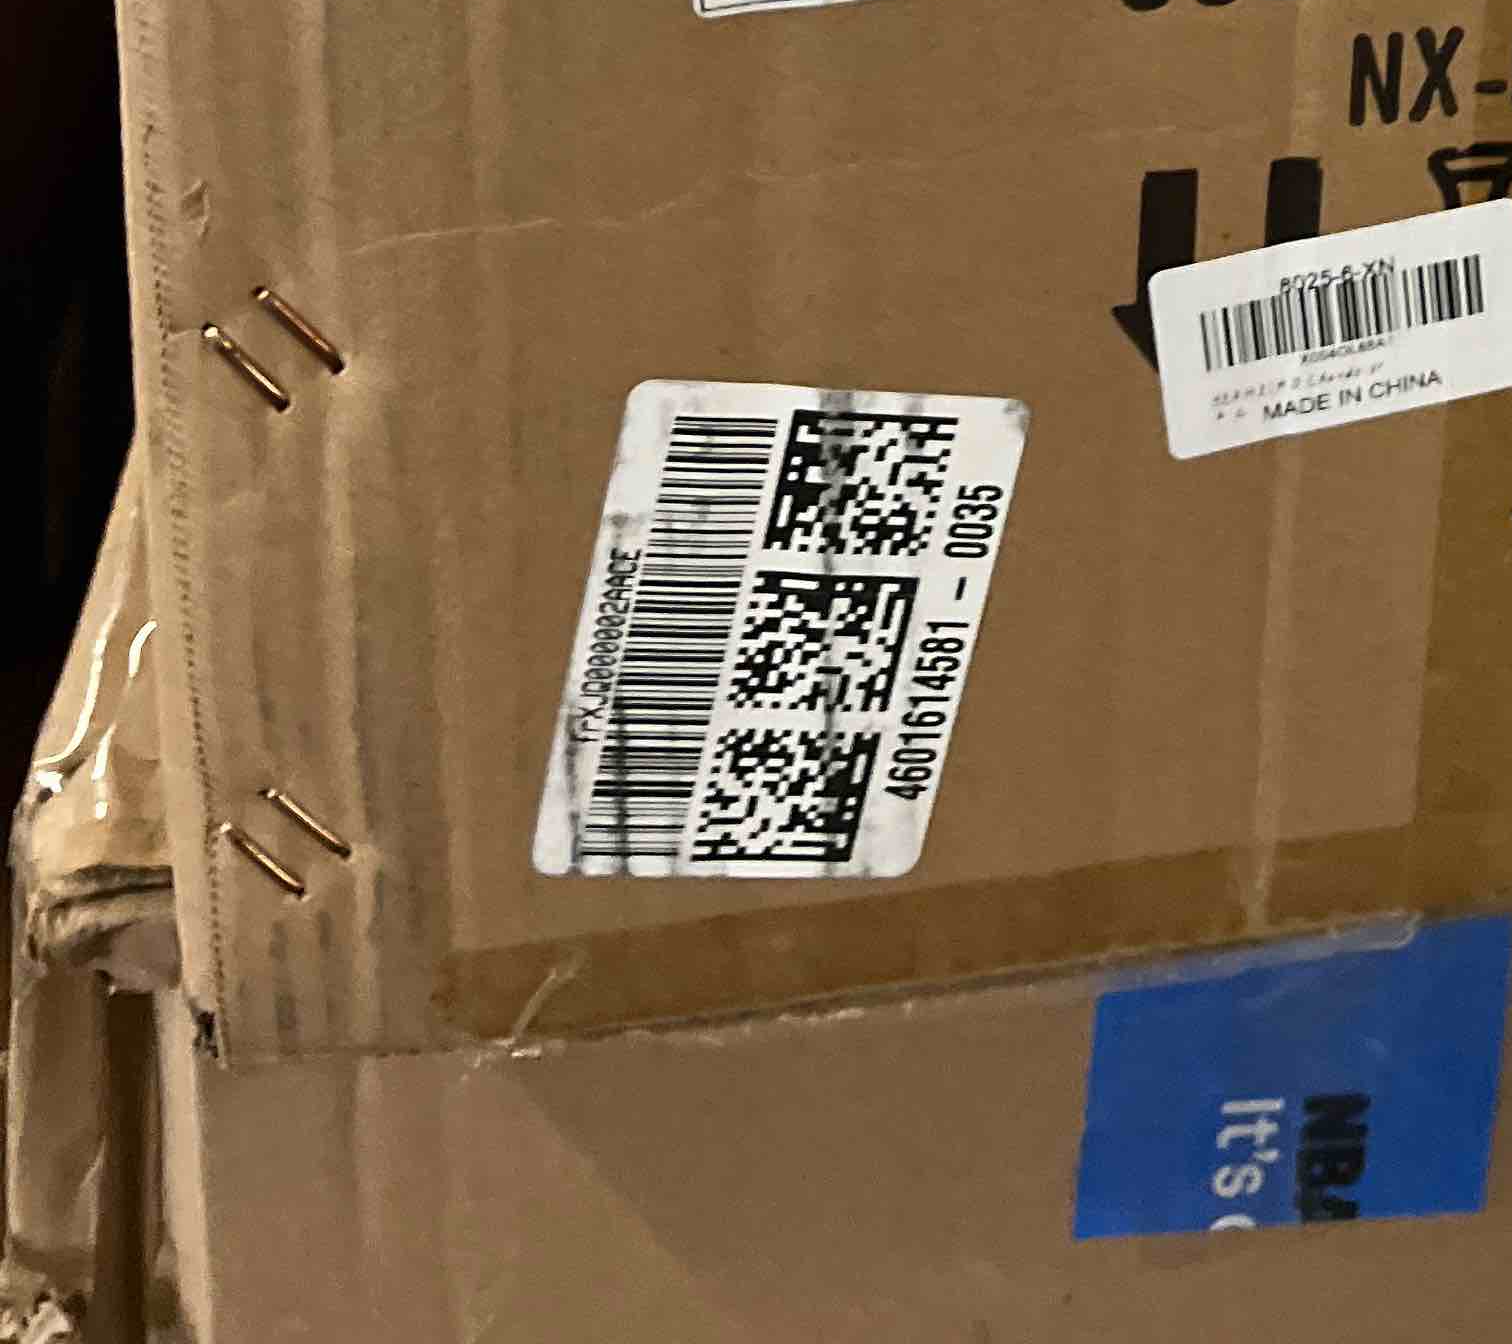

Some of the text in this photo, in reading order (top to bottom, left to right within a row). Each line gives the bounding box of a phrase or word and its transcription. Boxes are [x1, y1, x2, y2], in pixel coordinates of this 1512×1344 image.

[1263, 393, 1330, 423] MADE
[1338, 387, 1363, 407] IN
[1369, 368, 1443, 400] CHINA
[884, 619, 970, 801] 4601614581
[944, 483, 1004, 560] 0035
[1214, 1097, 1285, 1200] It's
